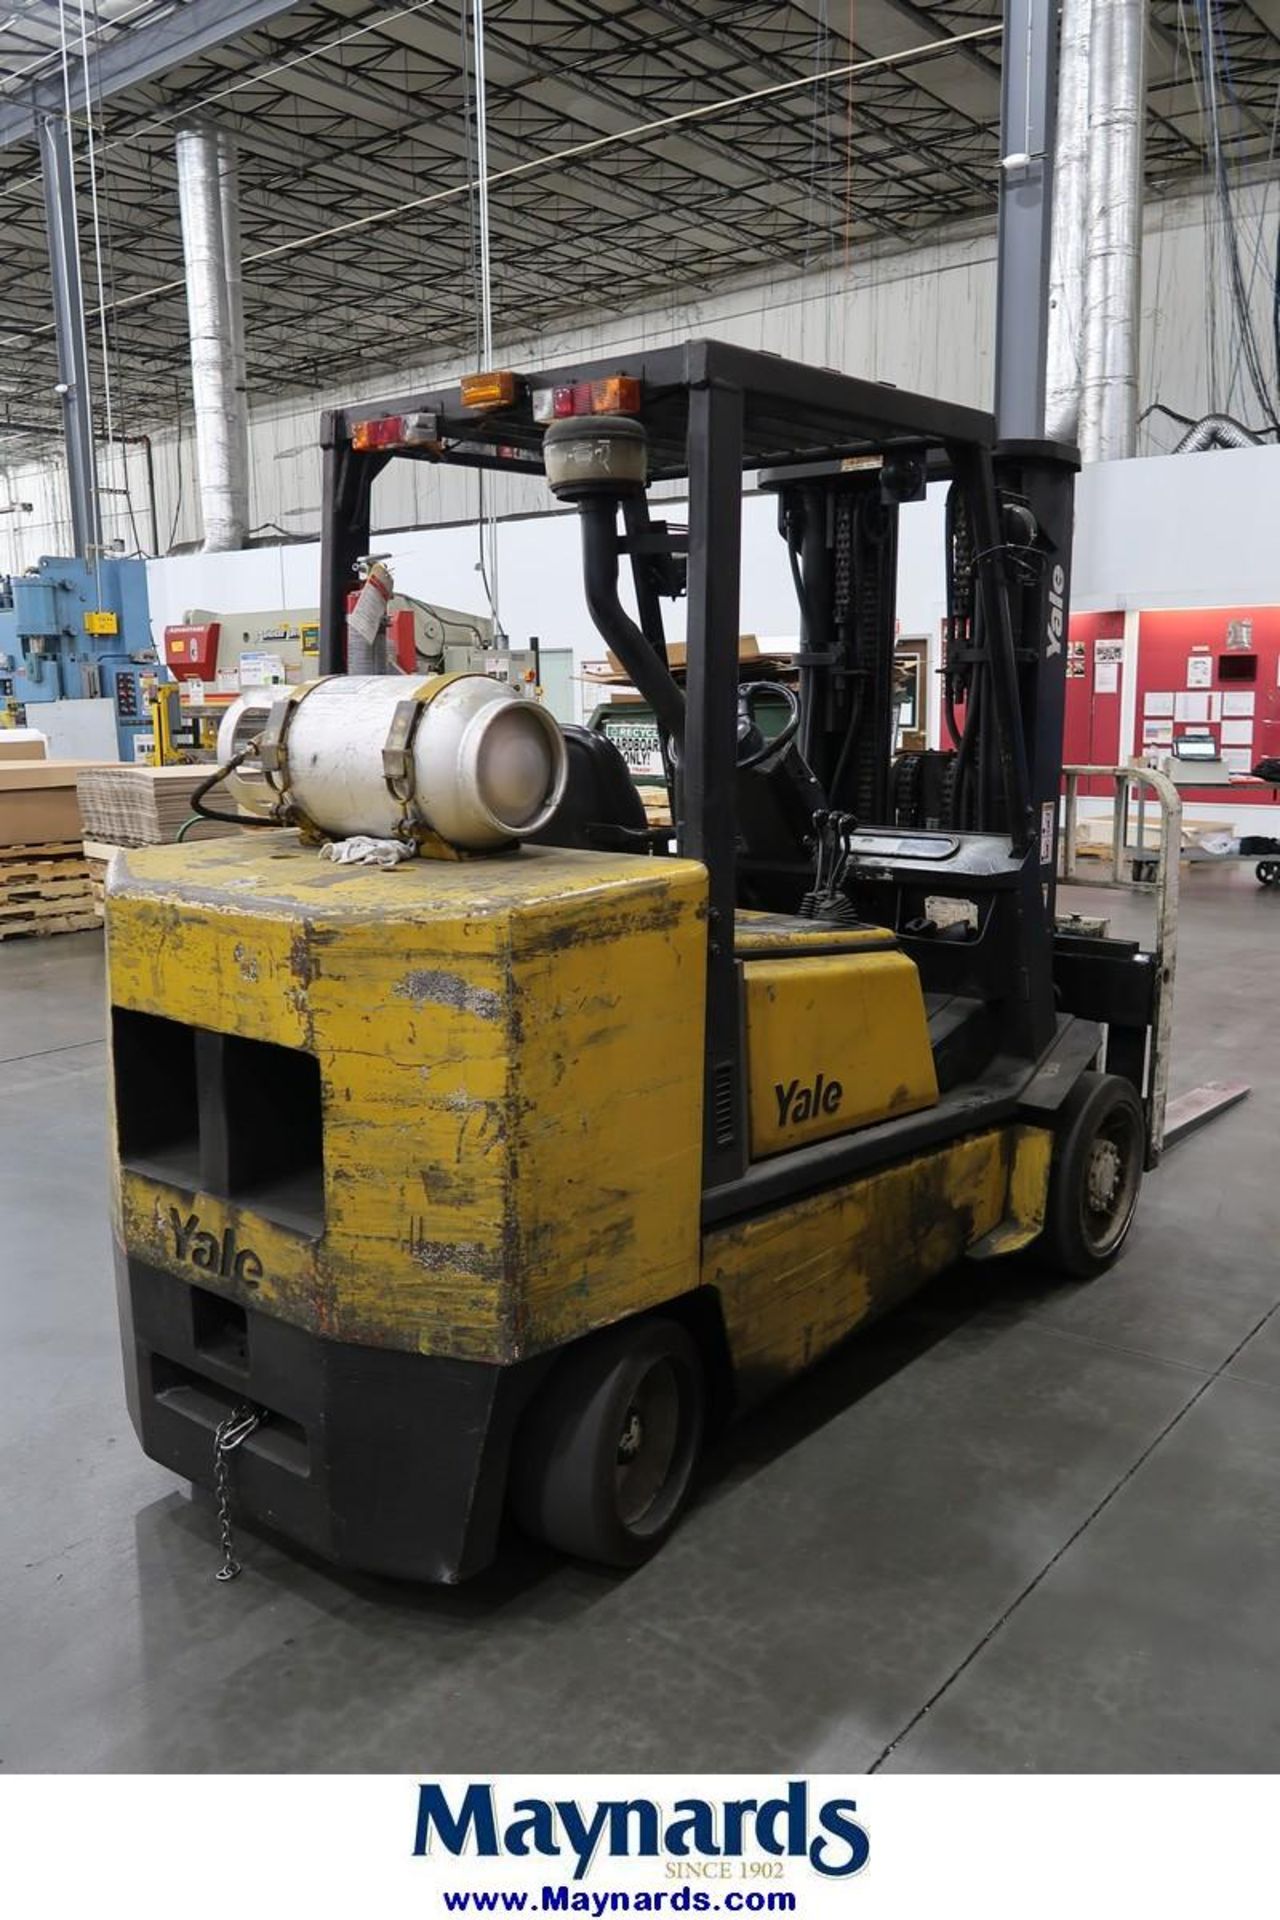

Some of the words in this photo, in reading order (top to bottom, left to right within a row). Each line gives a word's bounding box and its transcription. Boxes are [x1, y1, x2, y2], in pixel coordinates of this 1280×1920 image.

[1046, 564, 1065, 659] Yale
[619, 727, 659, 737] RECYCL
[624, 751, 651, 765] ONLY!
[774, 1073, 844, 1127] Yale
[166, 1207, 265, 1290] Yale
